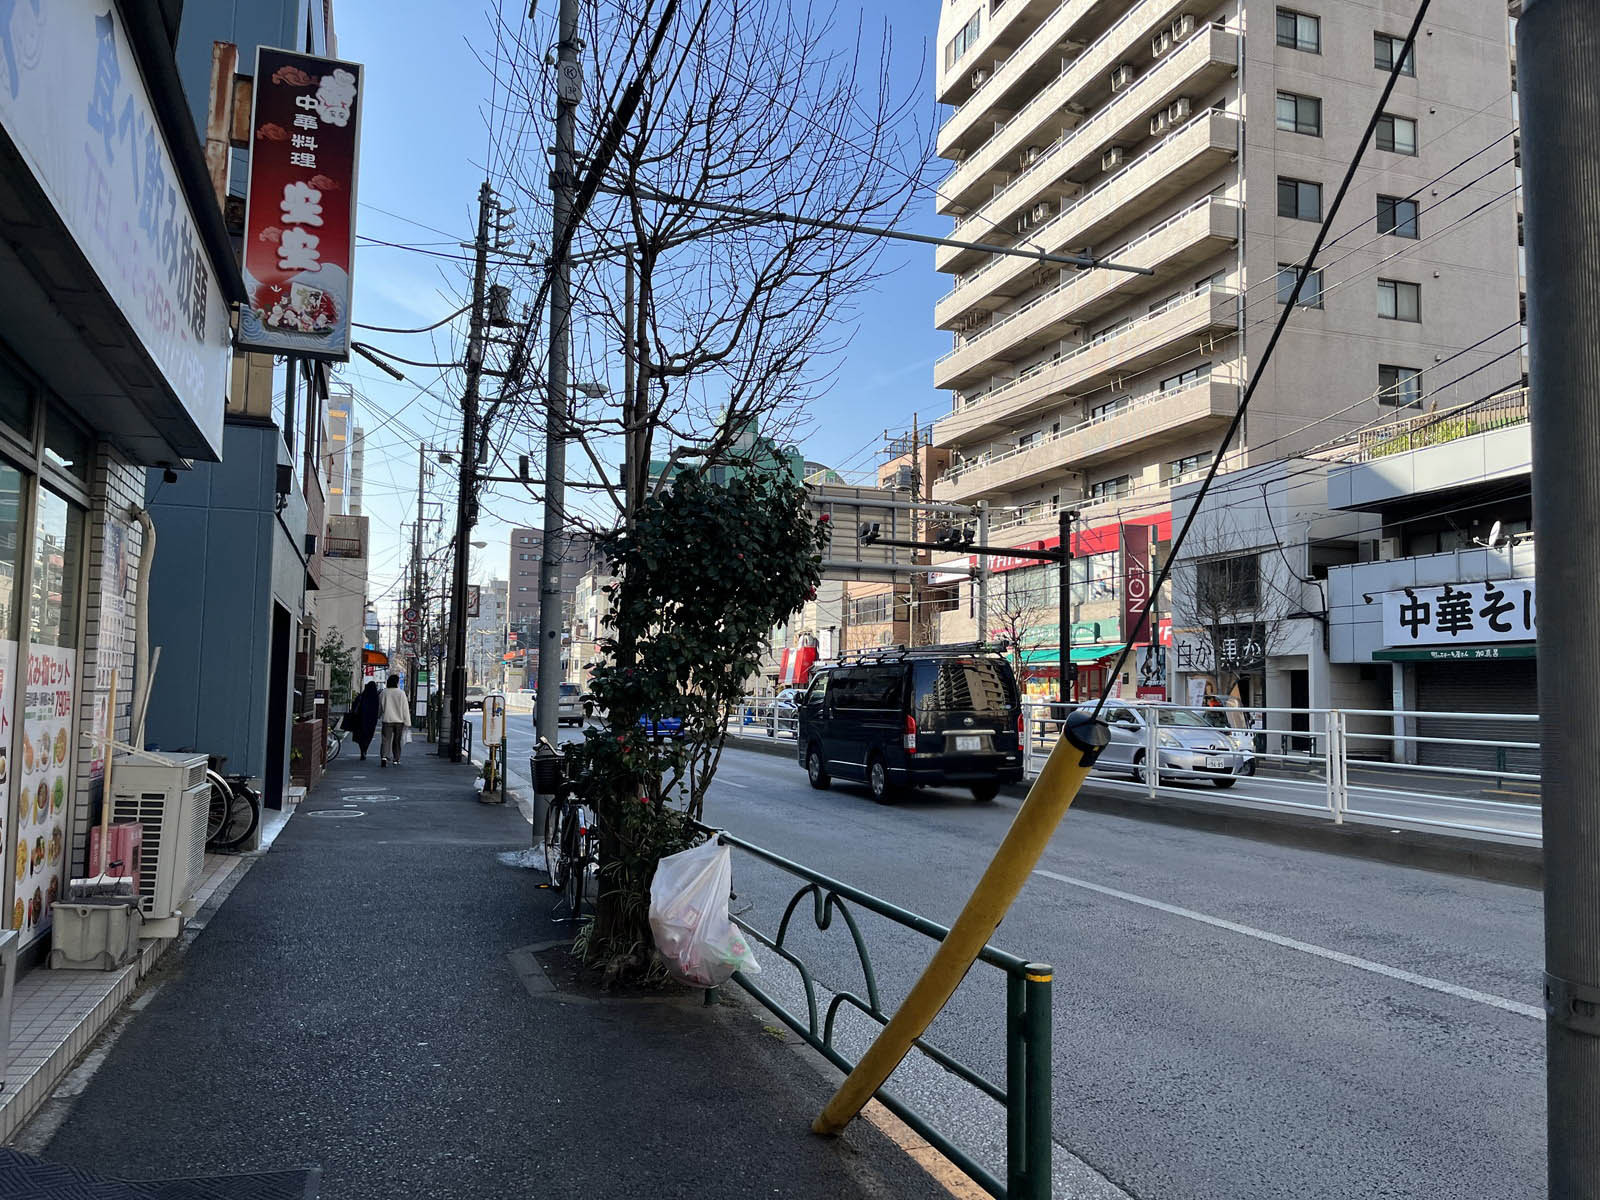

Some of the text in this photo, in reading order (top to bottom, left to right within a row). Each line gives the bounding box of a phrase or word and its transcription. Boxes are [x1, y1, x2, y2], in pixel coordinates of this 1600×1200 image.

[290, 94, 319, 168] 中華料理
[1178, 640, 1211, 668] 白か
